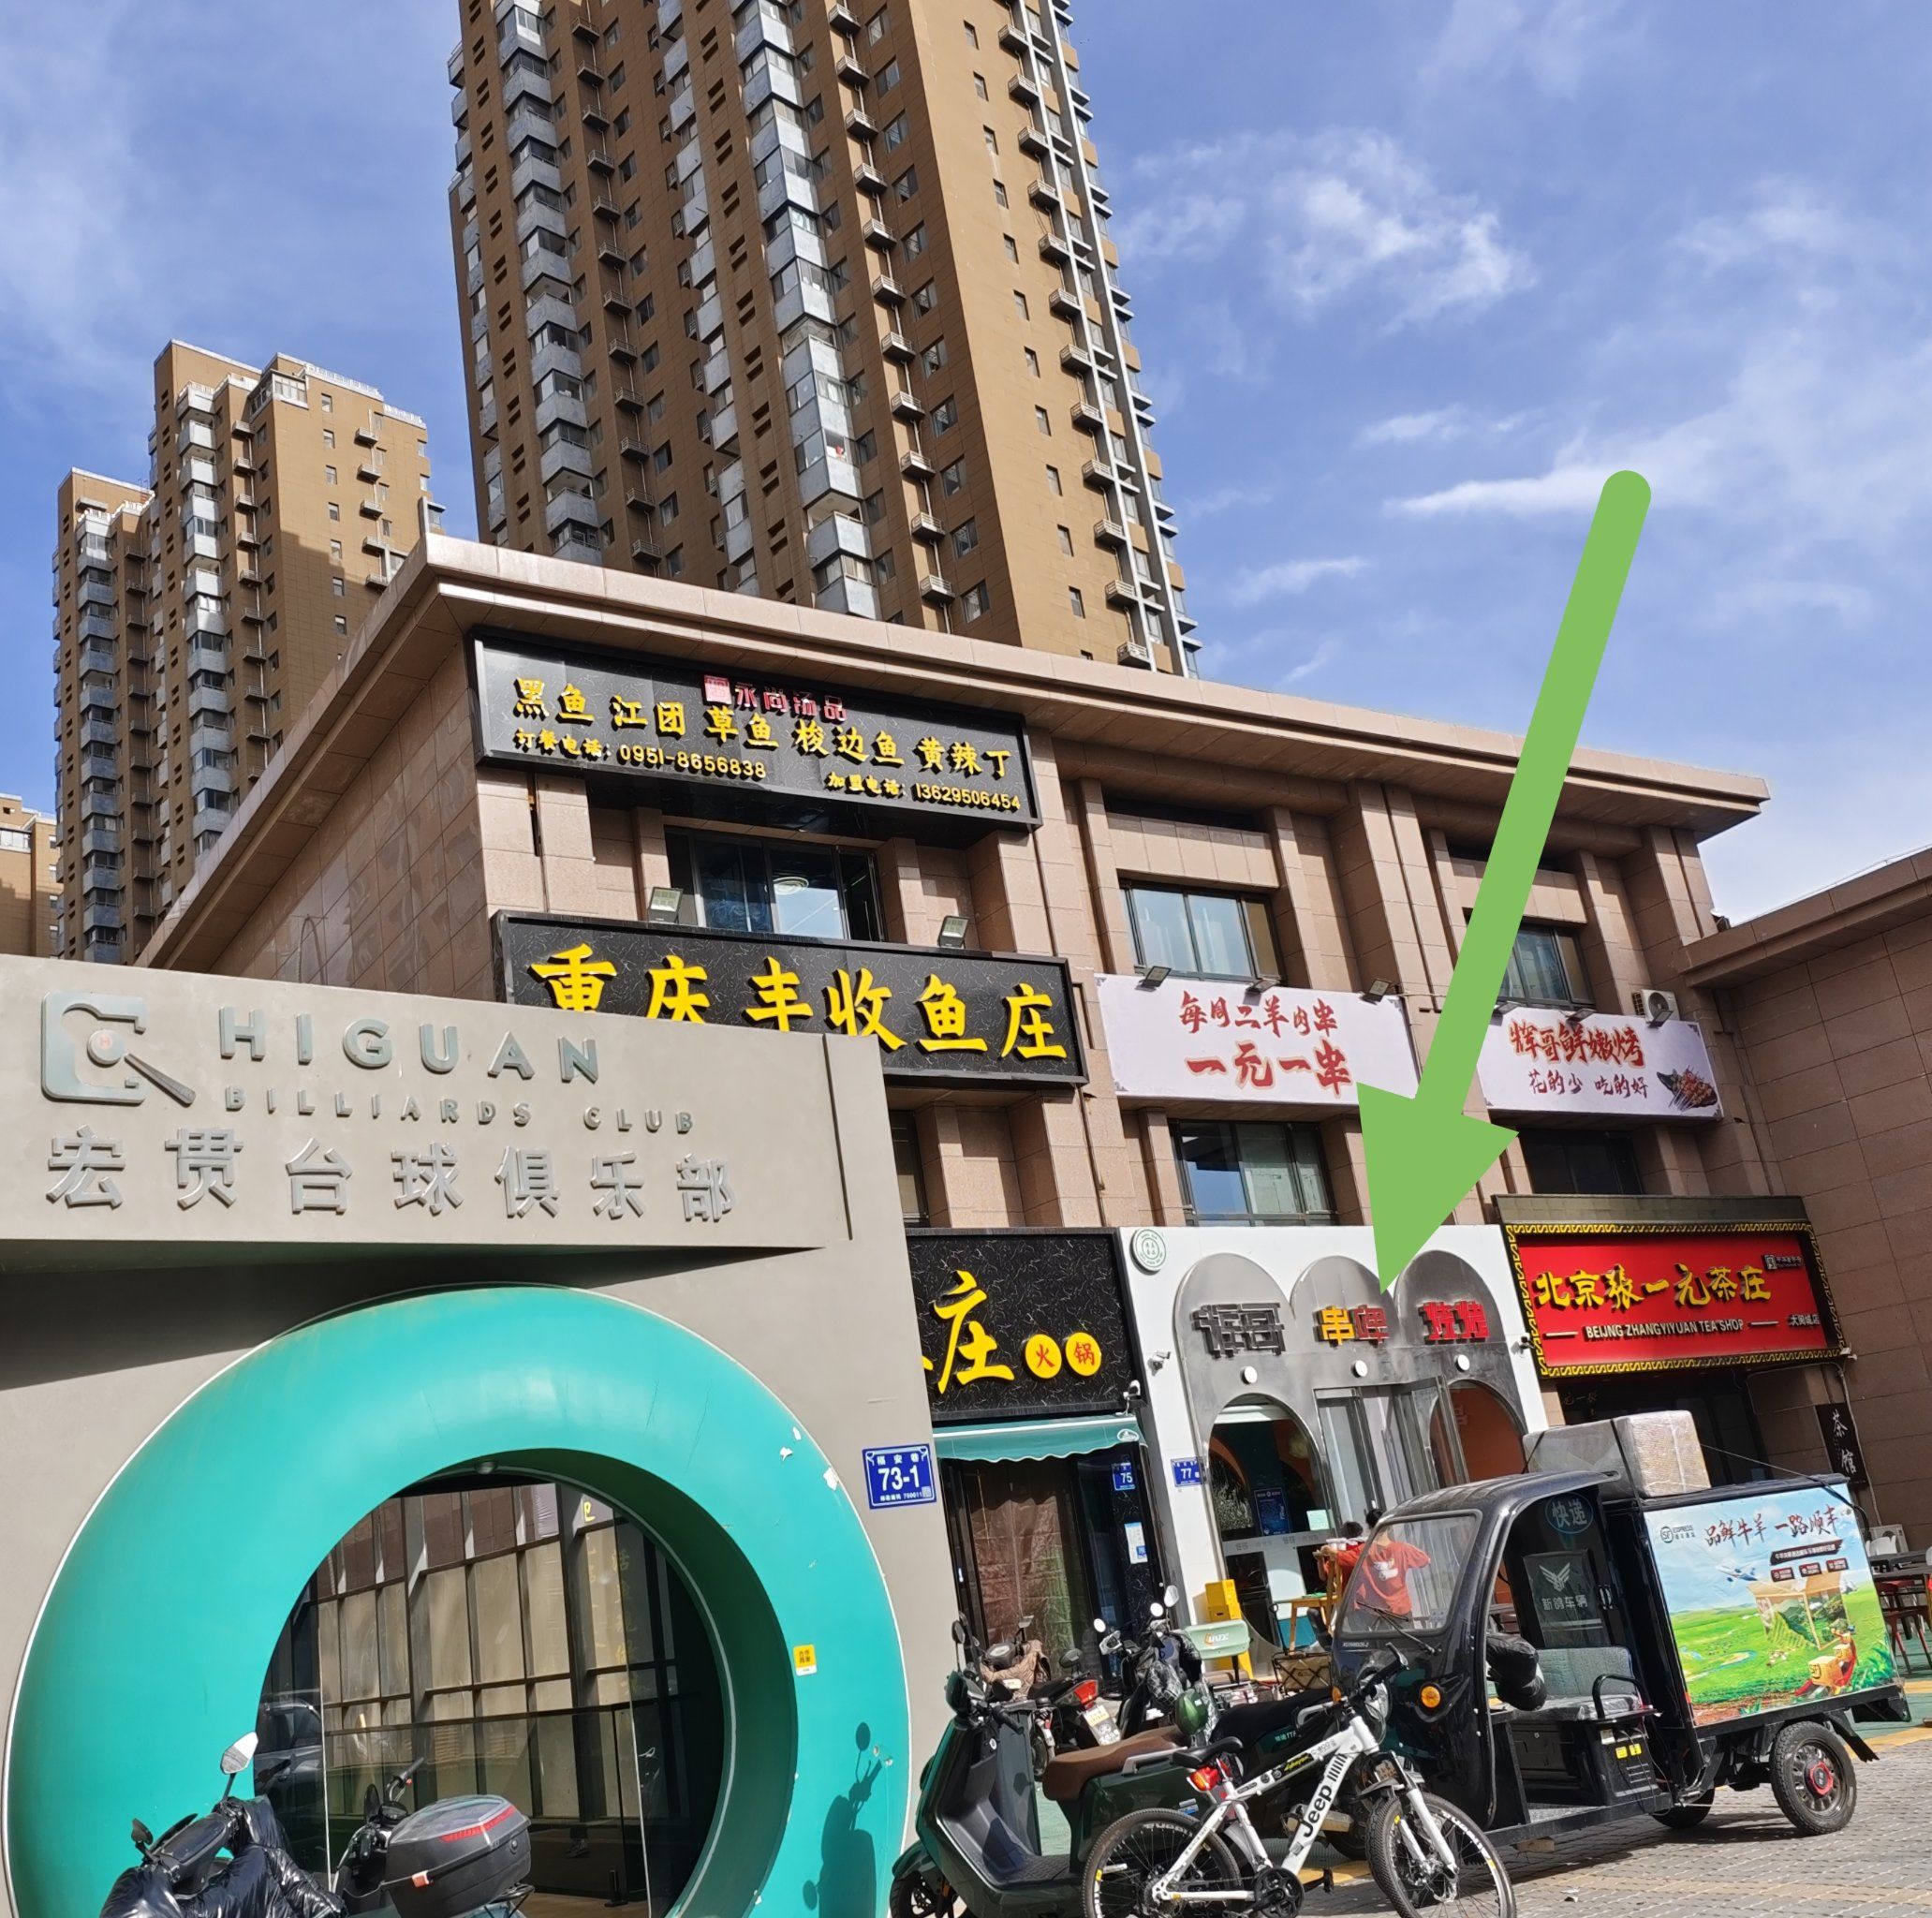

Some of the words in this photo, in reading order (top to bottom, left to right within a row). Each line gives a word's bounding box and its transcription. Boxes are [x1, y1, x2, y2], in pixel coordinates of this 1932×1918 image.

[514, 677, 595, 722] 黑鱼
[610, 695, 686, 737] 江团
[706, 705, 779, 748] 草鱼
[795, 719, 905, 765] 梭边鱼
[917, 736, 1011, 777] 黄辣丁
[532, 944, 1068, 1059] 重庆丰收鱼庄
[219, 1006, 599, 1084] HIGUAN
[1187, 1040, 1352, 1096] 一元一串
[1527, 1069, 1584, 1095] 花的少
[1594, 1074, 1649, 1099] 吃的好
[226, 1085, 531, 1127] BILLIARDS
[584, 1106, 694, 1134] CLUB
[46, 1126, 734, 1222] 宏贯台球俱乐部
[922, 1270, 1015, 1394] 庄
[1626, 1321, 1697, 1336] ZHANGYIYUAN
[1699, 1320, 1718, 1333] TEA
[1719, 1319, 1744, 1331] SHOP
[1036, 1341, 1096, 1368] 火锅
[878, 1465, 920, 1491] 73-1
[1120, 1472, 1133, 1483] 75
[1180, 1468, 1192, 1480] 77
[1552, 1499, 1587, 1527] 快递
[1541, 1595, 1588, 1611] 新鸽车辆
[1303, 1785, 1333, 1837] Jeep
